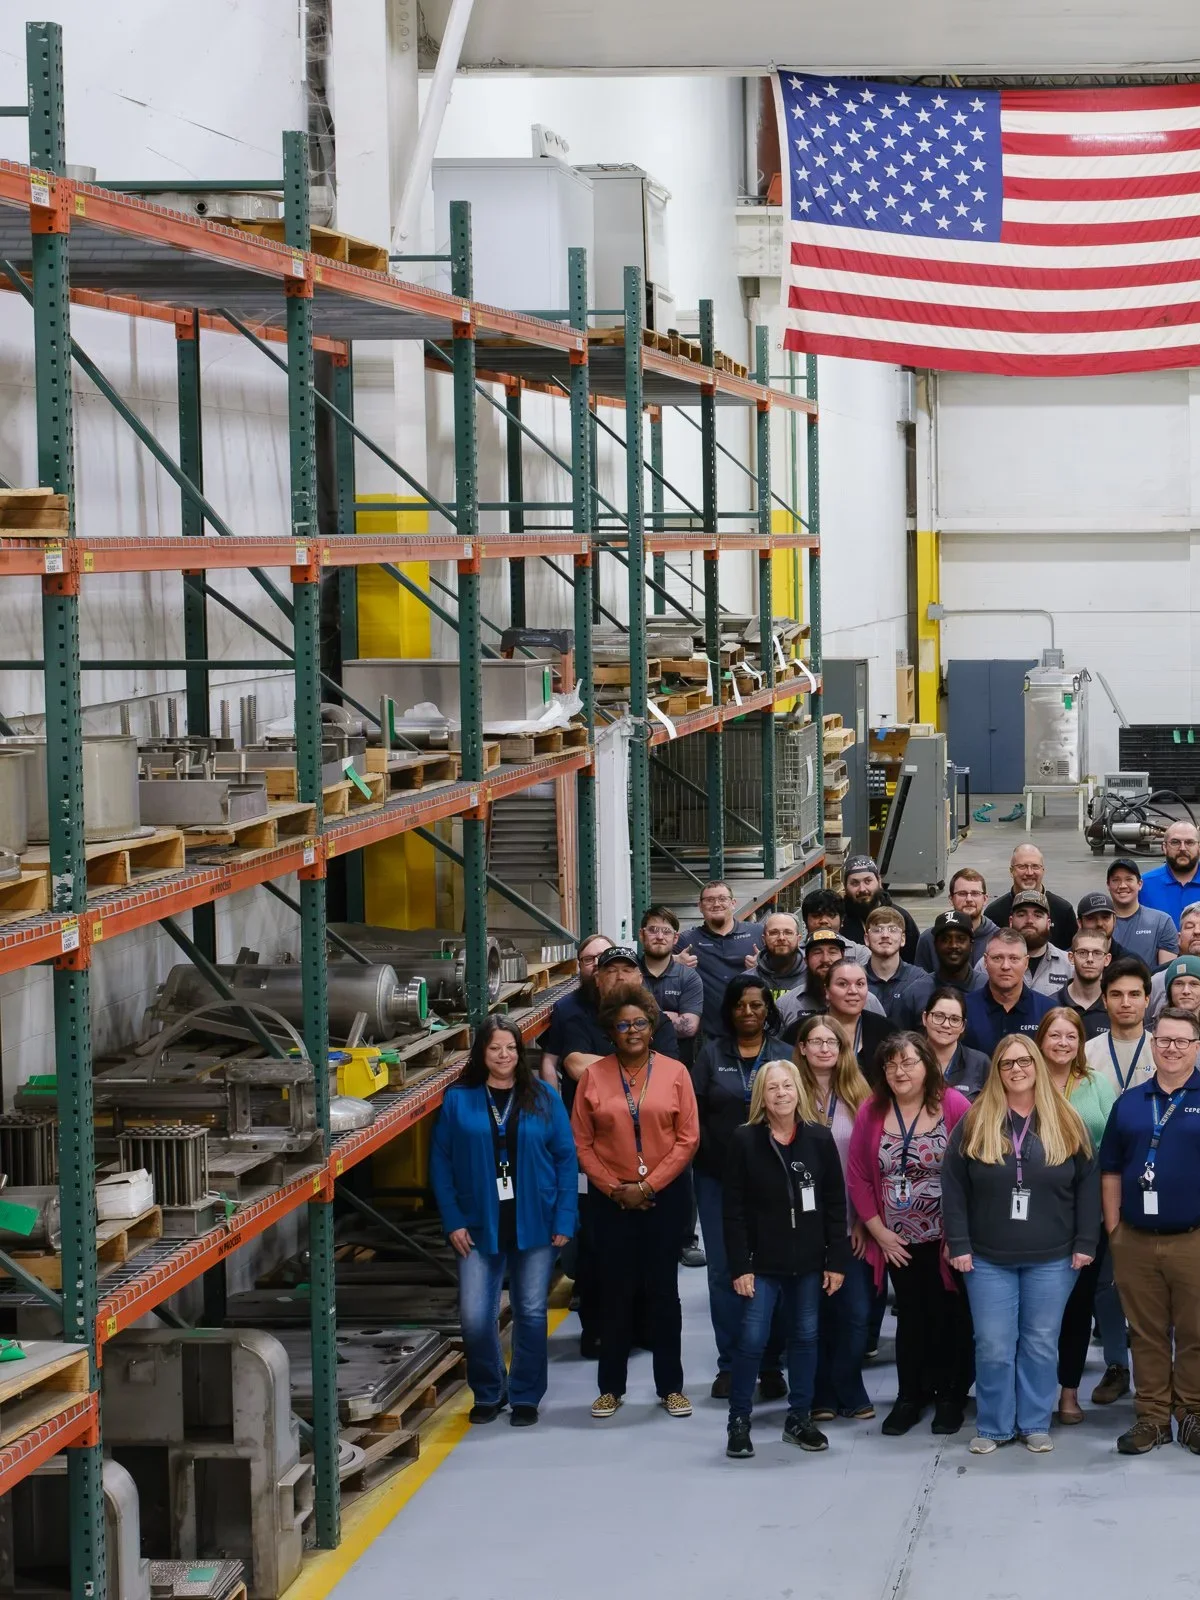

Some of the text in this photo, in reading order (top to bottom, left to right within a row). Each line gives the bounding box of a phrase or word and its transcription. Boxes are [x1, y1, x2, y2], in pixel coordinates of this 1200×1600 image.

[945, 910, 960, 924] L
[1159, 1103, 1177, 1126] CEPEDA
[218, 1233, 241, 1256] IN PROCESS
